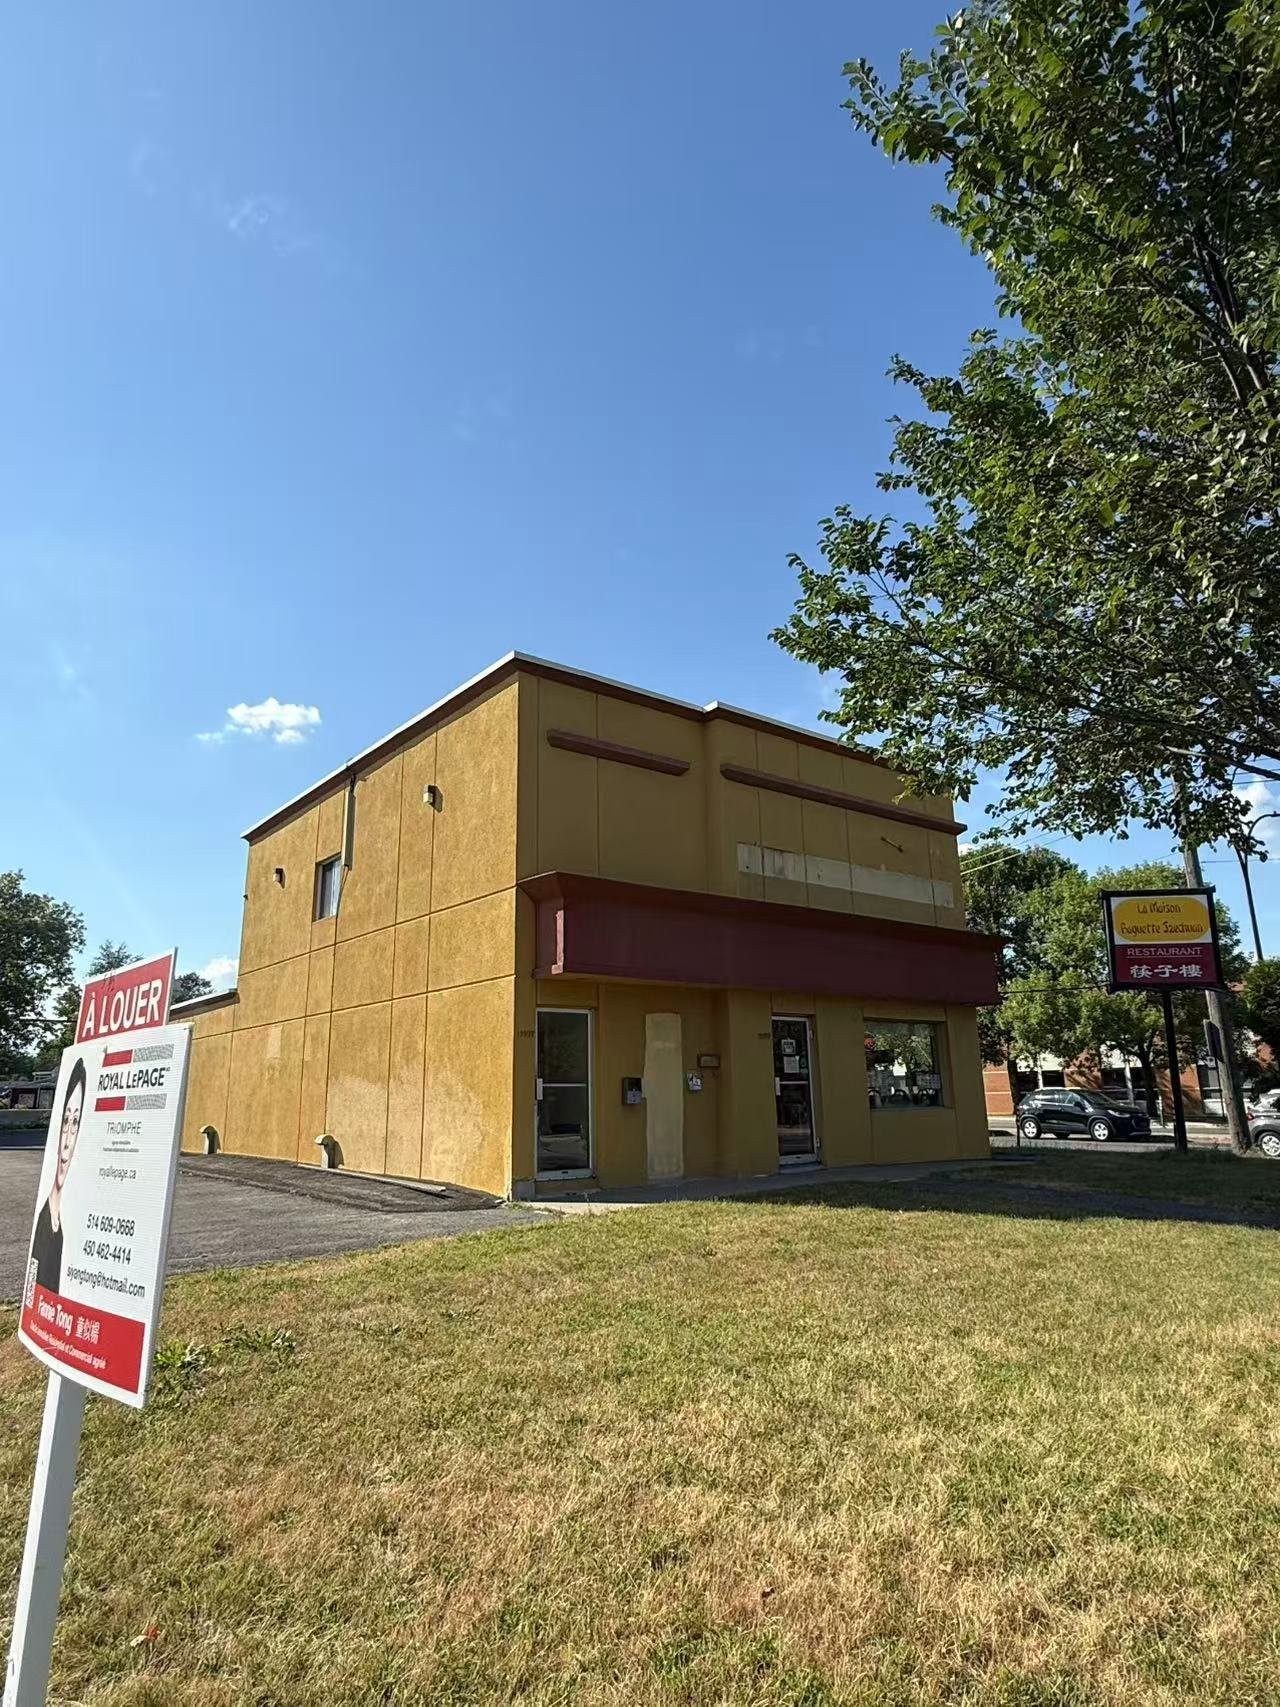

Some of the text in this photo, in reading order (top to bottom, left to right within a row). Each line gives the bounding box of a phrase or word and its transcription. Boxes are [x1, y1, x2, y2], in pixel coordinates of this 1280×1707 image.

[1150, 902, 1181, 914] Maison
[1127, 947, 1201, 956] RESTAURANT
[82, 978, 163, 1038] À LOUER
[97, 1073, 124, 1093] ROYAL
[106, 1121, 142, 1135] TRIOMPHE
[99, 1165, 137, 1182] royallepage.ca
[87, 1213, 135, 1237] 514 609-0668
[83, 1240, 131, 1264] 450 462-4414
[55, 1303, 74, 1336] Tong
